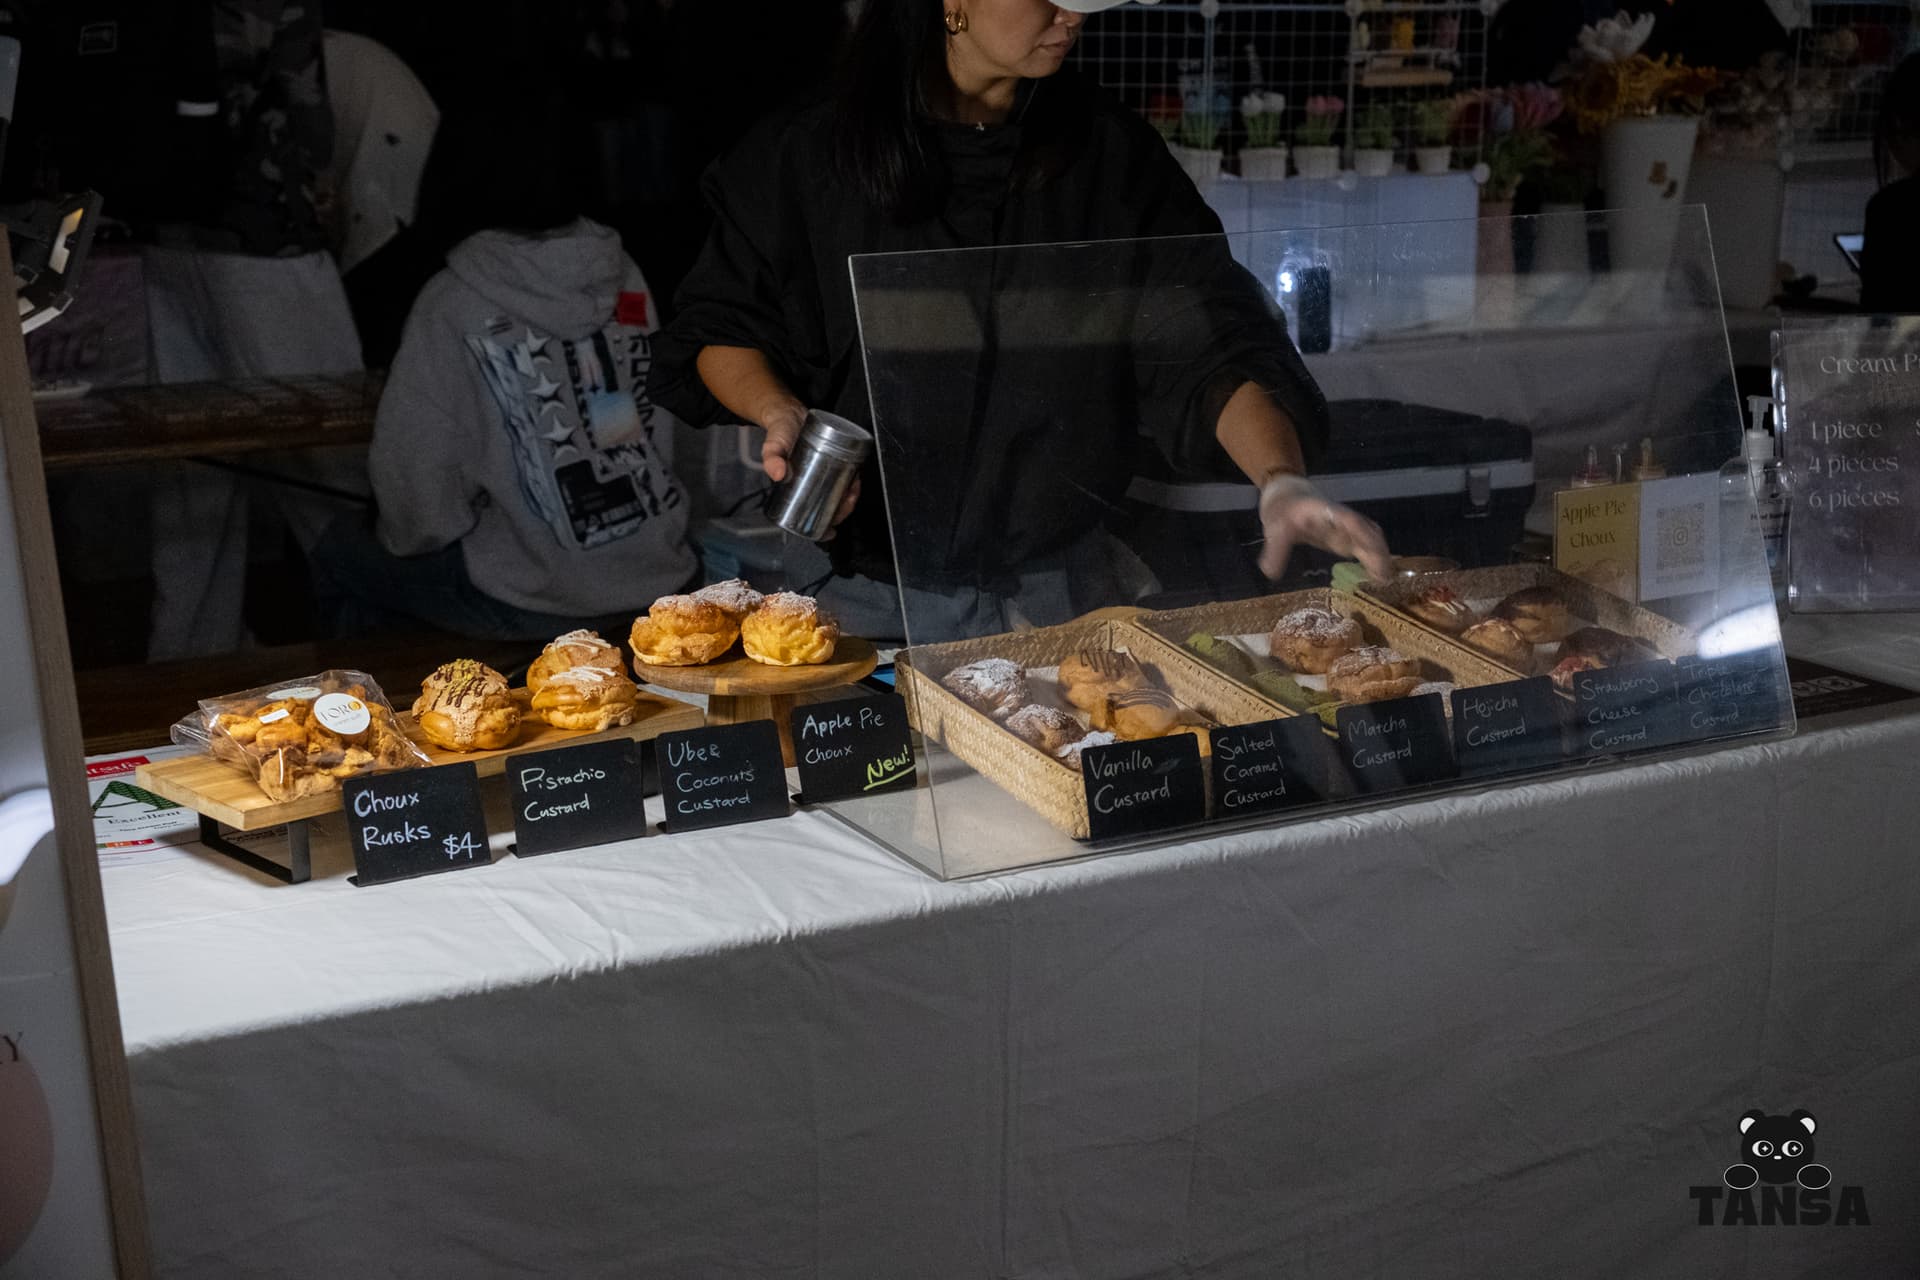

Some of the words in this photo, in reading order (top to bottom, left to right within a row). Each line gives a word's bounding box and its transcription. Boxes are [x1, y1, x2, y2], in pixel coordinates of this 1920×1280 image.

[1820, 356, 1896, 374] Cream
[1904, 353, 1920, 372] P
[1824, 420, 1882, 444] piece
[1809, 456, 1821, 474] 4
[1828, 455, 1899, 478] pieces
[1561, 504, 1600, 525] Apple
[1604, 500, 1627, 519] Pie
[1809, 490, 1822, 508] 6
[1829, 488, 1900, 512] pieces
[1569, 530, 1616, 549] Choux
[1580, 677, 1660, 700] Strawberry
[1463, 696, 1519, 720] Hojicha
[1587, 705, 1641, 725] Cheese
[802, 714, 851, 740] Apple
[859, 707, 885, 729] Pie
[1350, 714, 1408, 742] Matcha
[1466, 718, 1527, 747] Custard
[1216, 729, 1276, 761] Salted
[1589, 726, 1648, 750] Custard
[805, 744, 853, 765] Choux
[866, 744, 912, 786] New!
[1088, 749, 1153, 780] Vanilla
[1352, 738, 1413, 769] Custard
[520, 767, 606, 793] Pistachio
[1223, 755, 1285, 783] Caramel
[354, 789, 420, 818] Choux
[677, 789, 751, 814] Custard
[1094, 775, 1171, 814] Custard
[1223, 777, 1286, 808] Custard
[524, 793, 590, 822] Custard
[362, 821, 432, 850] Rusks
[442, 831, 481, 860] $4
